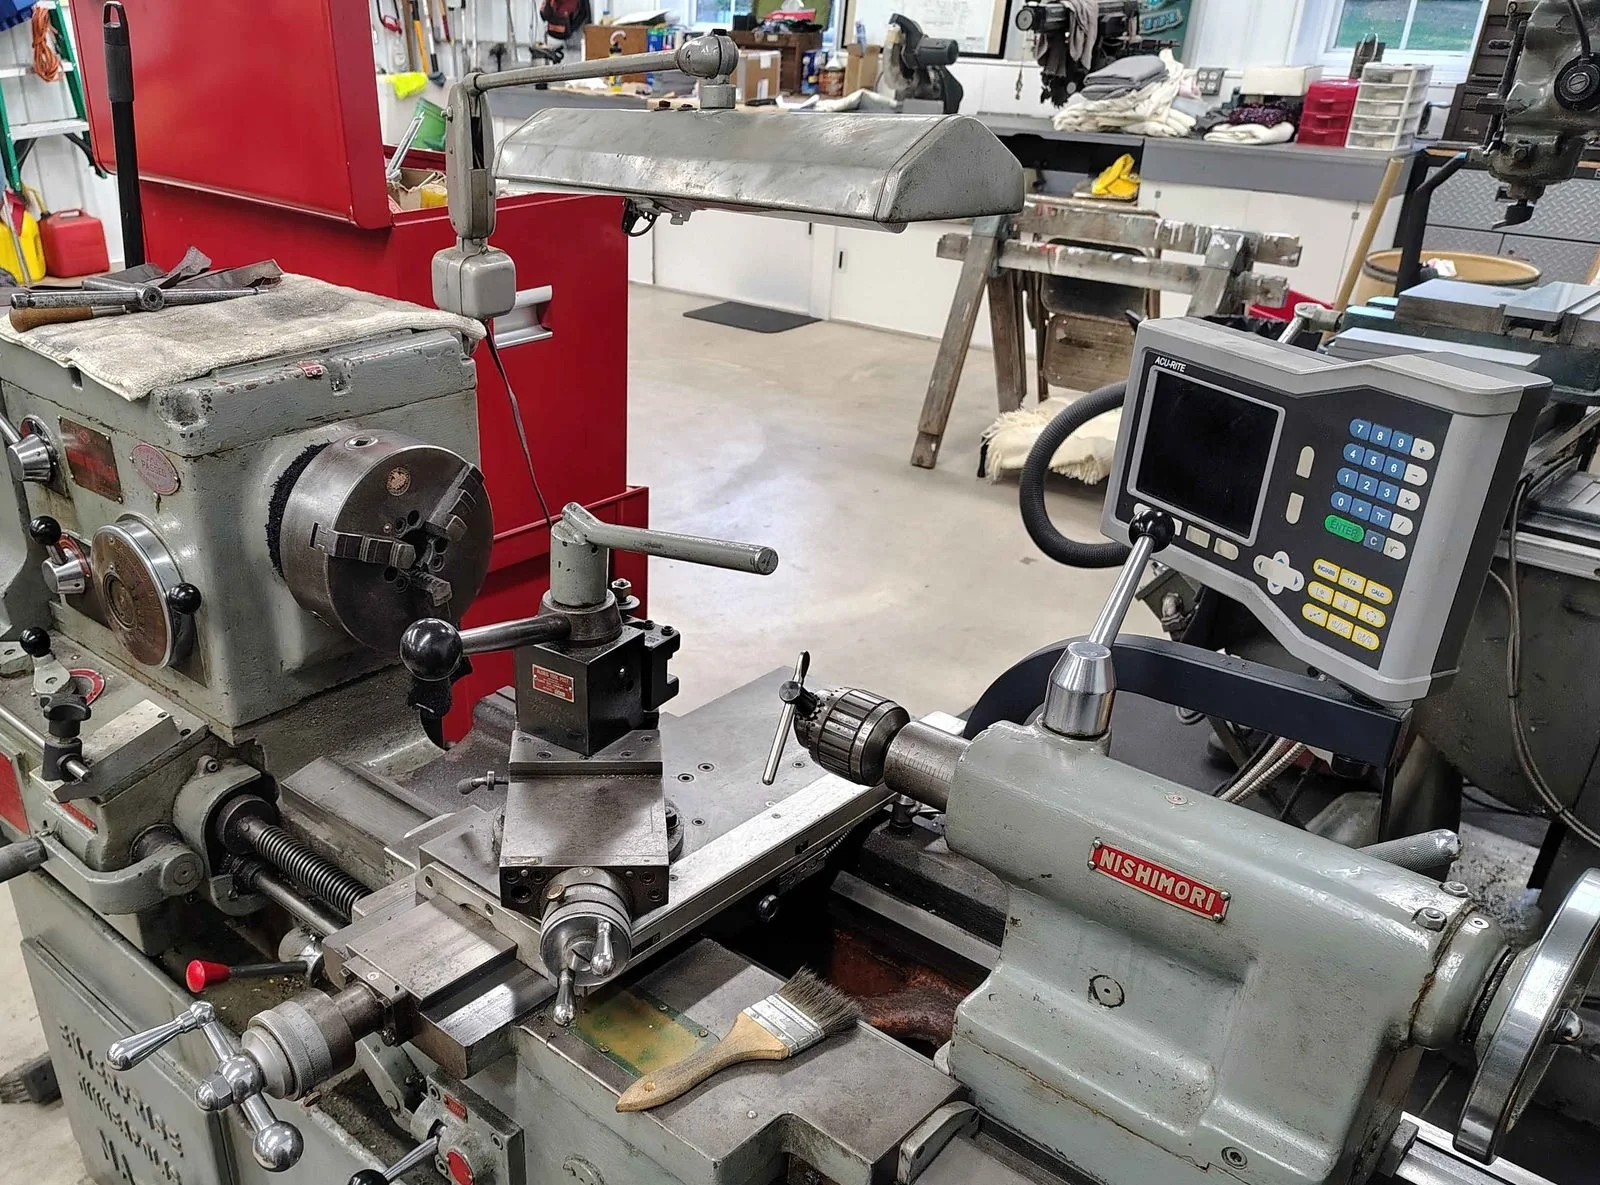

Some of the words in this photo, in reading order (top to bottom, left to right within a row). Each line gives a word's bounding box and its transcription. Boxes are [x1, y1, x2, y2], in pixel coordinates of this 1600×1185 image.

[1154, 356, 1187, 373] ACU-RITE
[1357, 424, 1364, 434] 7
[1376, 431, 1383, 441] 8
[1397, 438, 1404, 448] 9
[1349, 449, 1357, 458] 4
[1370, 456, 1377, 466] 5
[1390, 463, 1398, 473] 6
[1344, 473, 1350, 483] 1
[1363, 481, 1371, 491] 2
[1383, 488, 1391, 498] 3
[1337, 497, 1344, 507] 0
[1330, 519, 1359, 539] ENTER
[1370, 536, 1378, 546] C
[1370, 587, 1386, 599] CALC
[1099, 848, 1216, 912] NISHIMORI
